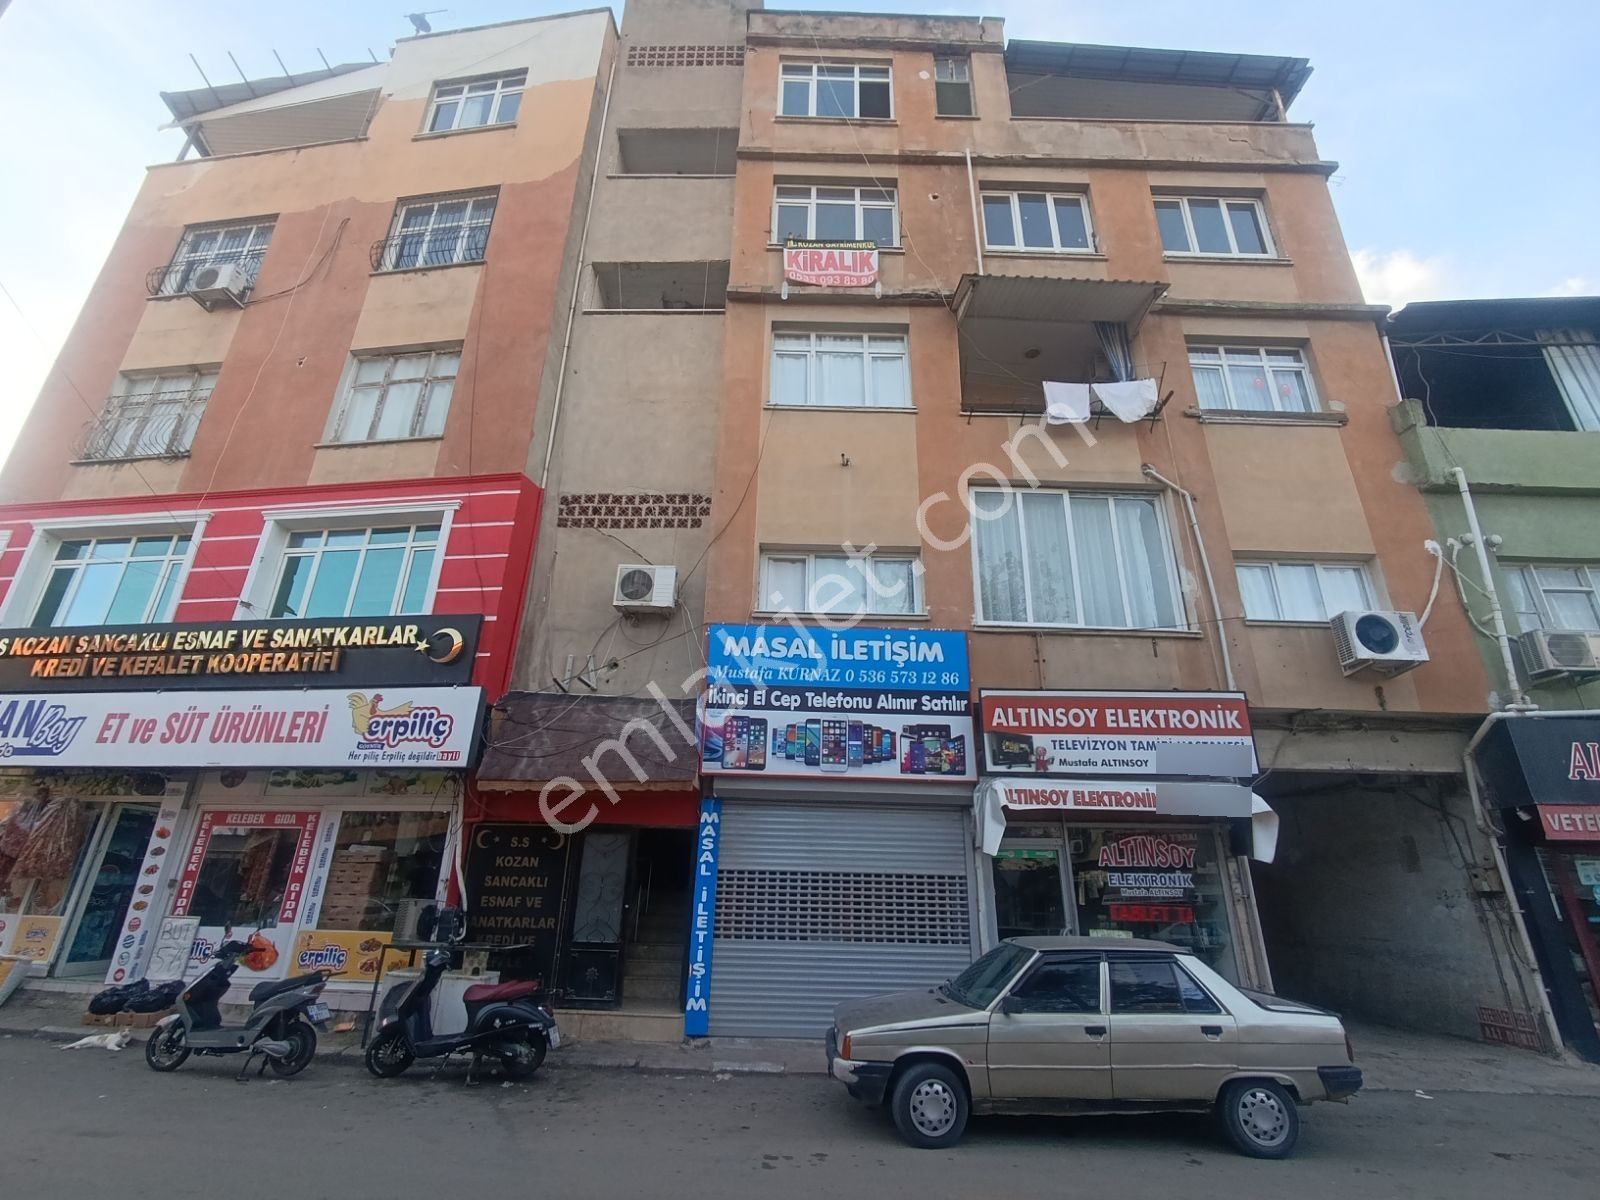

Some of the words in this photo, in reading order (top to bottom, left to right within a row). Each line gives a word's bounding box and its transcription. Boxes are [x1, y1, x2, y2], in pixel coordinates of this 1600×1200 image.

[789, 271, 816, 283] 0533
[820, 275, 840, 285] 093
[844, 275, 857, 285] 83
[861, 275, 874, 285] 80
[9, 635, 75, 656] KOZAN
[76, 632, 169, 654] SANCAKLI
[173, 630, 238, 650] ESNAF
[242, 628, 267, 648] VE
[270, 624, 418, 648] SANATKARLAR
[723, 636, 823, 659] MASAL
[831, 633, 944, 667] İLETİŞİM
[30, 654, 90, 678] KREDİ
[91, 656, 119, 677] VE
[119, 654, 204, 677] KEFALET
[205, 647, 340, 675] KOOPERATİFİ
[713, 664, 773, 681] Mustafa
[777, 666, 841, 682] KURNAZ
[845, 669, 854, 682] 0
[859, 670, 885, 684] 536
[890, 670, 917, 684] 573
[921, 671, 937, 684] 12
[941, 671, 959, 685] 86
[708, 684, 748, 707] İkinci
[753, 690, 766, 705] El
[770, 690, 800, 710] Cep
[805, 692, 872, 709] Telefonu
[877, 694, 916, 710] Alınır
[921, 694, 968, 712] Satılır
[27, 705, 87, 755] Bey
[96, 713, 130, 744] ET
[133, 717, 158, 744] ve
[160, 705, 209, 744] SÜT
[209, 704, 331, 744] ÜRÜNLERİ
[365, 710, 450, 744] erpiliç
[991, 706, 1098, 728] ALTINSOY
[1105, 704, 1242, 730] ELEKTRONİK
[348, 751, 361, 760] Her
[381, 751, 405, 763] Erpiliç
[1051, 736, 1127, 751] TELEVİZYON
[1059, 757, 1098, 768] Mustafa
[1101, 757, 1149, 768] ALTINSOY
[226, 813, 266, 824] KELEBEK
[274, 814, 296, 824] GIDA
[187, 813, 213, 871] KELEBEK
[294, 814, 317, 874] KELEBEK
[510, 837, 530, 848] S.S
[700, 812, 719, 876] MASAL
[1098, 836, 1196, 868] ALTINSOY
[495, 856, 539, 867] KOZAN
[484, 876, 548, 888] SANCAKLI
[1108, 871, 1195, 888] ELEKTRONİK
[174, 881, 193, 916] GIDA
[282, 883, 300, 919] GIDA
[480, 896, 522, 908] ESNAF
[526, 896, 543, 908] VE
[299, 946, 347, 969] erpiliç
